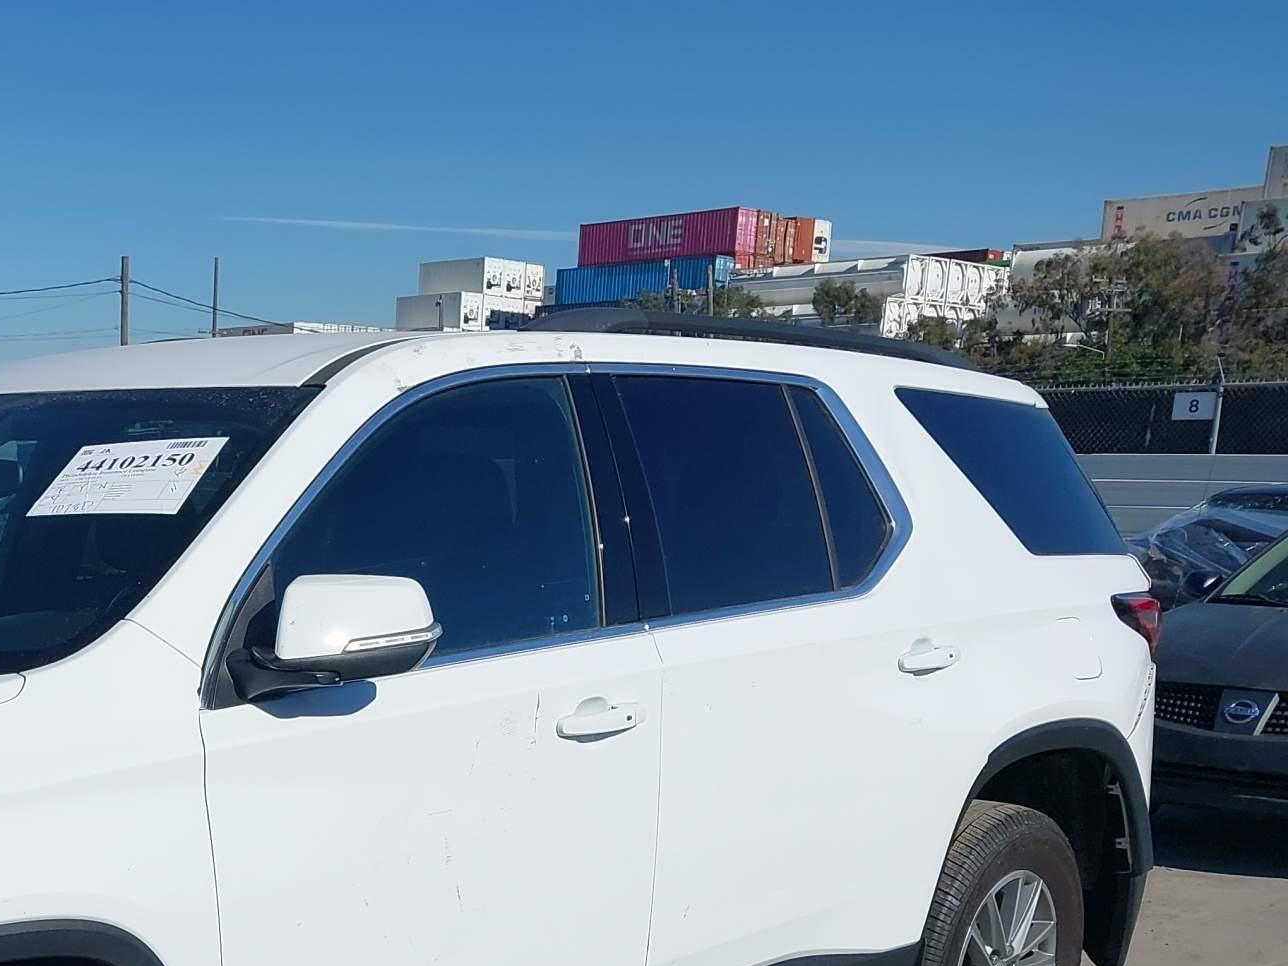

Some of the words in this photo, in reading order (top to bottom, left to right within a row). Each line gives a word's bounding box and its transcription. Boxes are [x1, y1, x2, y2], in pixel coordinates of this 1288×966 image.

[1166, 209, 1202, 223] CMA
[628, 219, 682, 248] ONE
[1189, 399, 1199, 413] 8
[76, 452, 196, 472] 44102150
